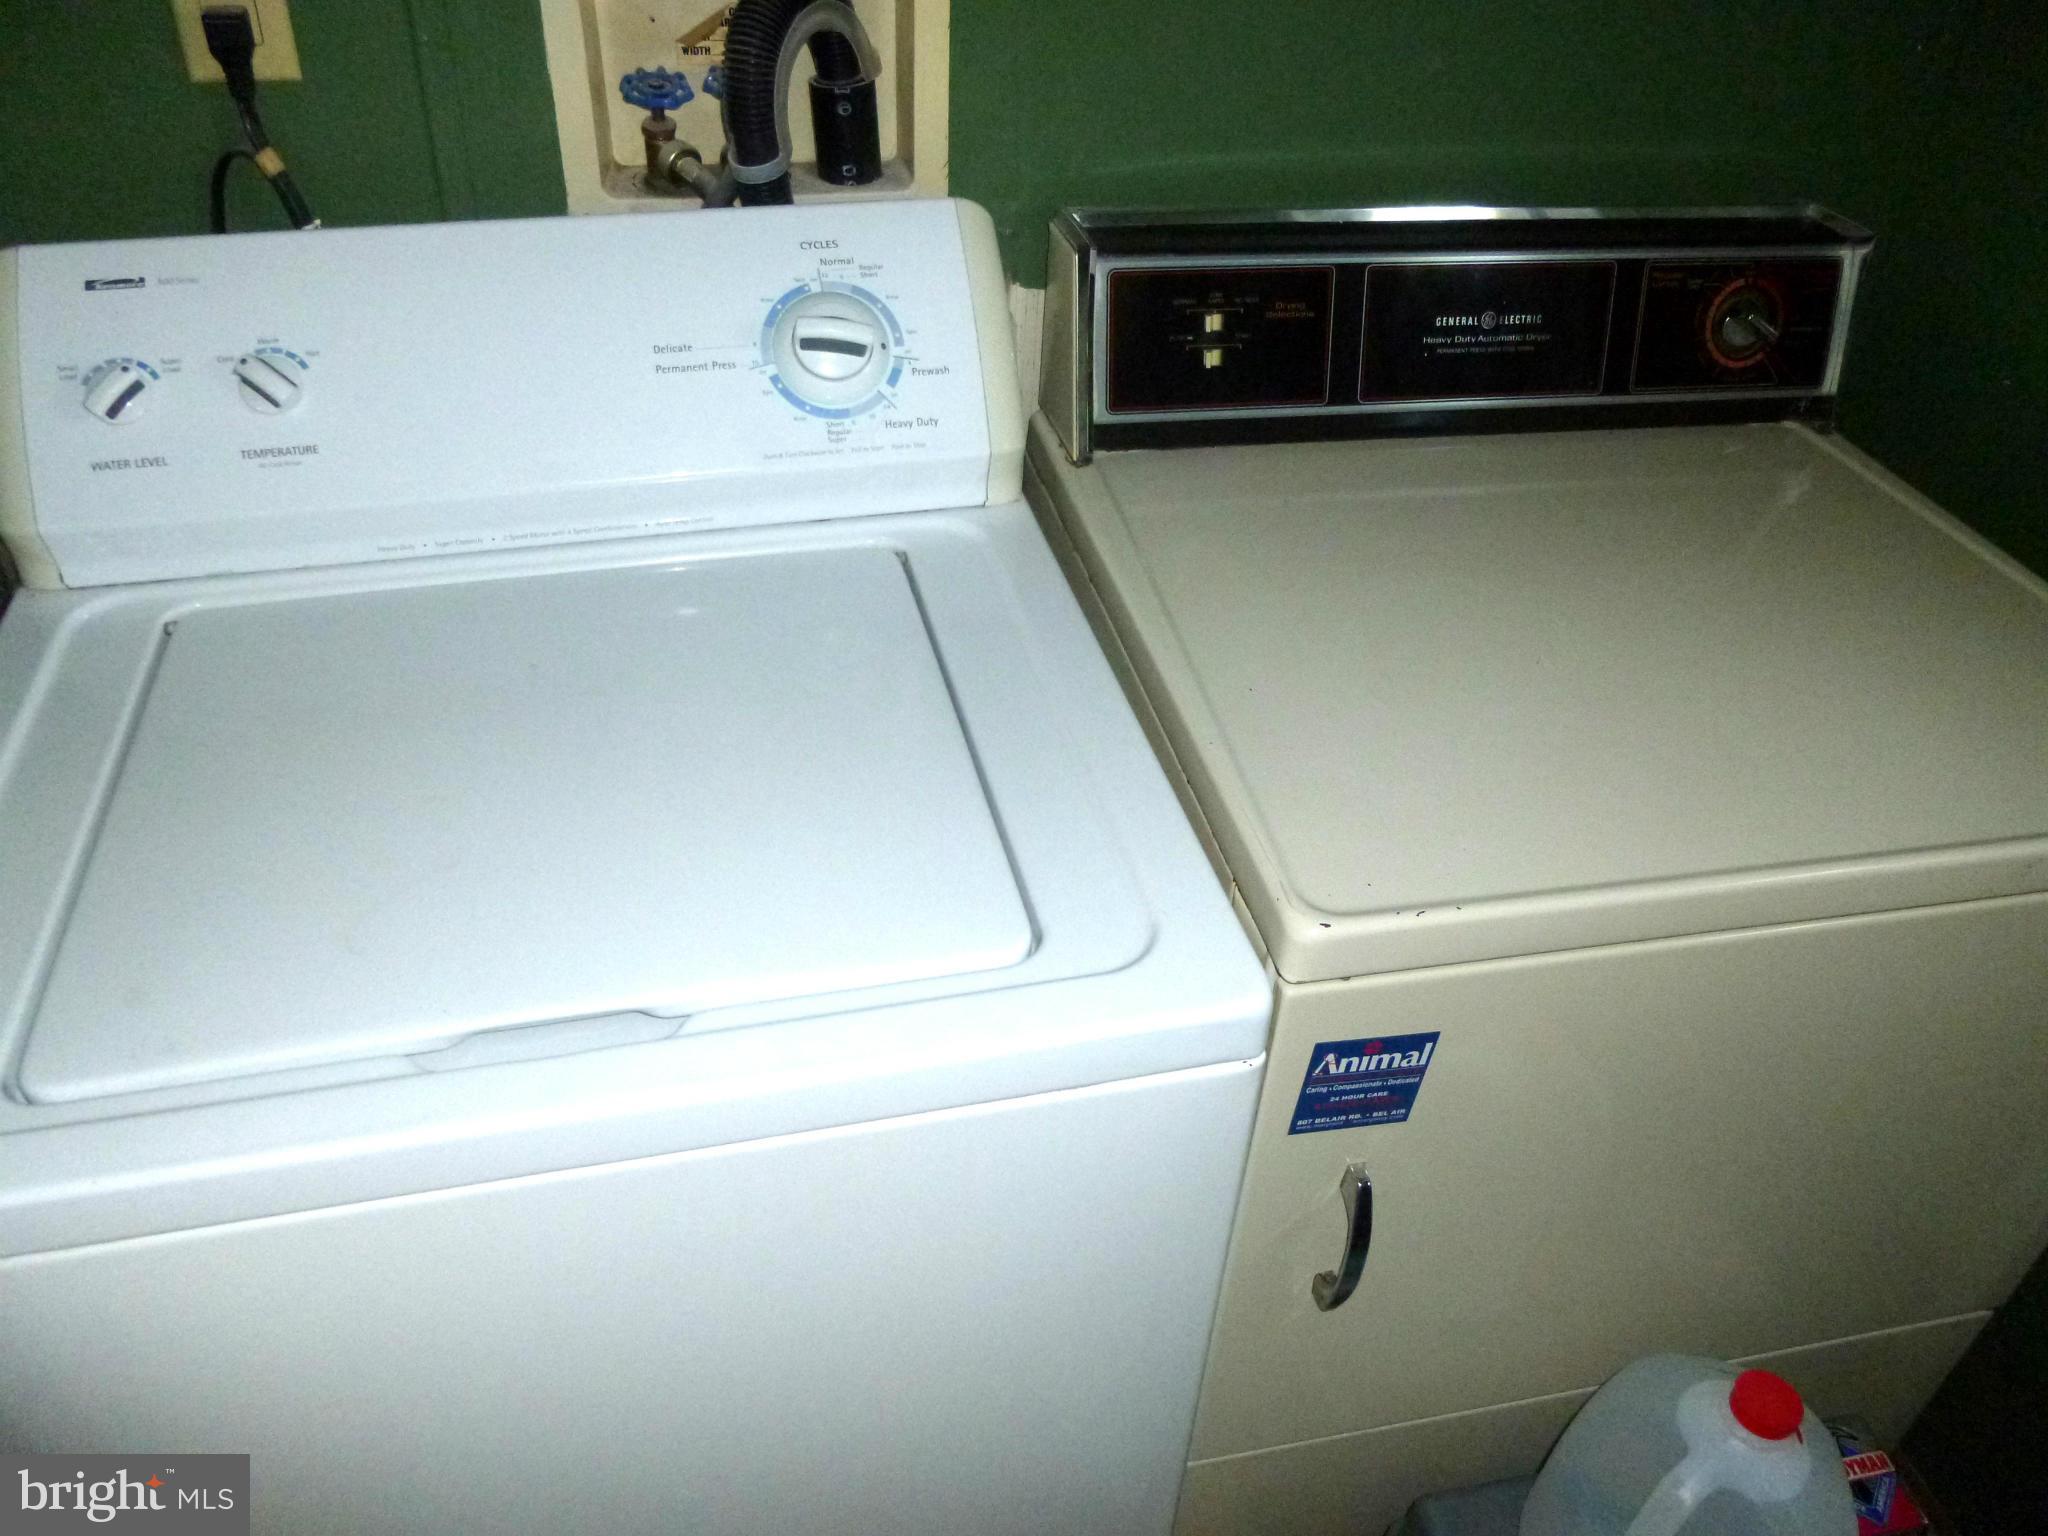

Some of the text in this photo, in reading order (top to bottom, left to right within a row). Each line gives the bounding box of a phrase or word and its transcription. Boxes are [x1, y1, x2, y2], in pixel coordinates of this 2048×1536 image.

[681, 46, 711, 56] WIDTH
[800, 240, 839, 250] CYCLES
[820, 257, 854, 266] Normal
[1436, 316, 1479, 327] GENERAL
[1499, 314, 1542, 325] ELECTRIC
[1423, 336, 1452, 345] Heavy
[1454, 335, 1476, 344] Duty
[1478, 333, 1524, 343] Automatic
[654, 344, 693, 354] Delicate
[655, 361, 737, 375] Permanent Press
[912, 365, 950, 377] Prewash
[885, 417, 939, 430] Heavy Duty
[241, 445, 319, 460] TEMPERATURE
[91, 456, 168, 472] WATER LEVEL
[1312, 1042, 1433, 1076] Animal
[1306, 1086, 1328, 1095] Caring
[1332, 1080, 1382, 1091] Compassionate
[1341, 1093, 1365, 1101] HOUR
